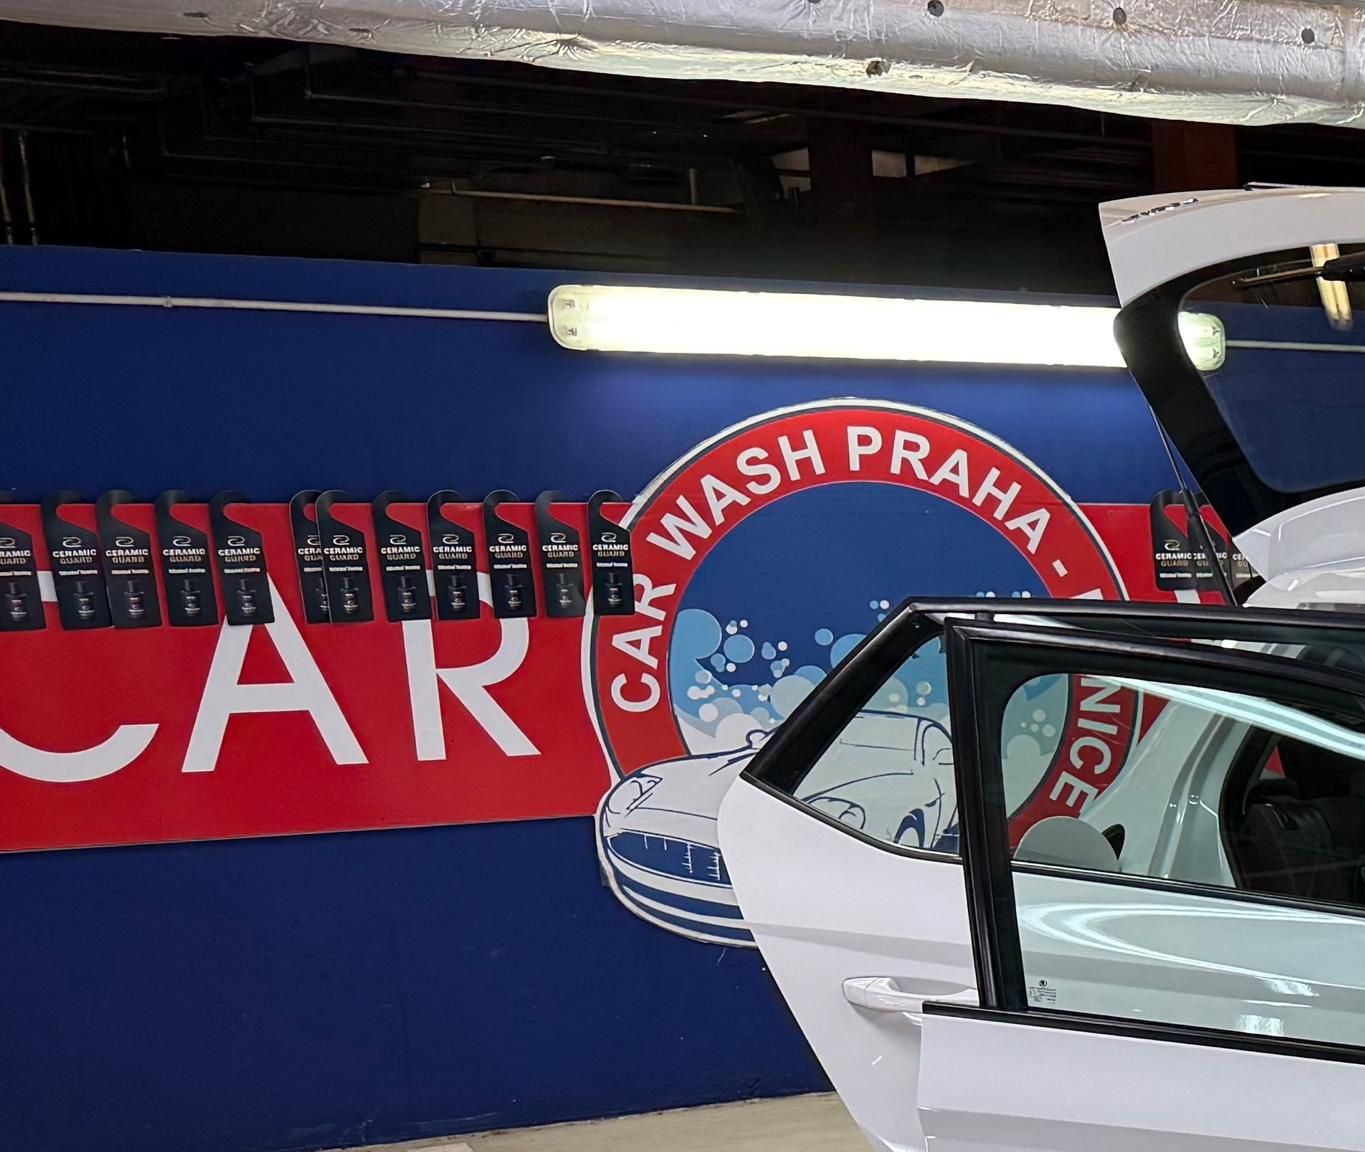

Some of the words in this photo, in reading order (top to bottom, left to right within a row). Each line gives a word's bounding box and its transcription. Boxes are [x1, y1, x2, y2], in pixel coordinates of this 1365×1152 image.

[646, 429, 826, 561] WASH
[847, 425, 1051, 555] PRAHA
[218, 547, 261, 556] CERAMIC
[298, 547, 322, 556] CERA
[323, 546, 363, 554] CERAMIC
[380, 546, 421, 555] CERAMIC
[433, 545, 473, 553] CERAMIC
[489, 545, 527, 553] CERAMIC
[541, 544, 579, 552] CERAMIC
[592, 543, 629, 551] CERAMIC
[52, 549, 97, 558] CERAMIC
[105, 548, 149, 557] CERAMIC
[162, 548, 206, 557] CERAMIC
[1155, 552, 1193, 561] CERAMIC
[611, 573, 677, 713] CAR
